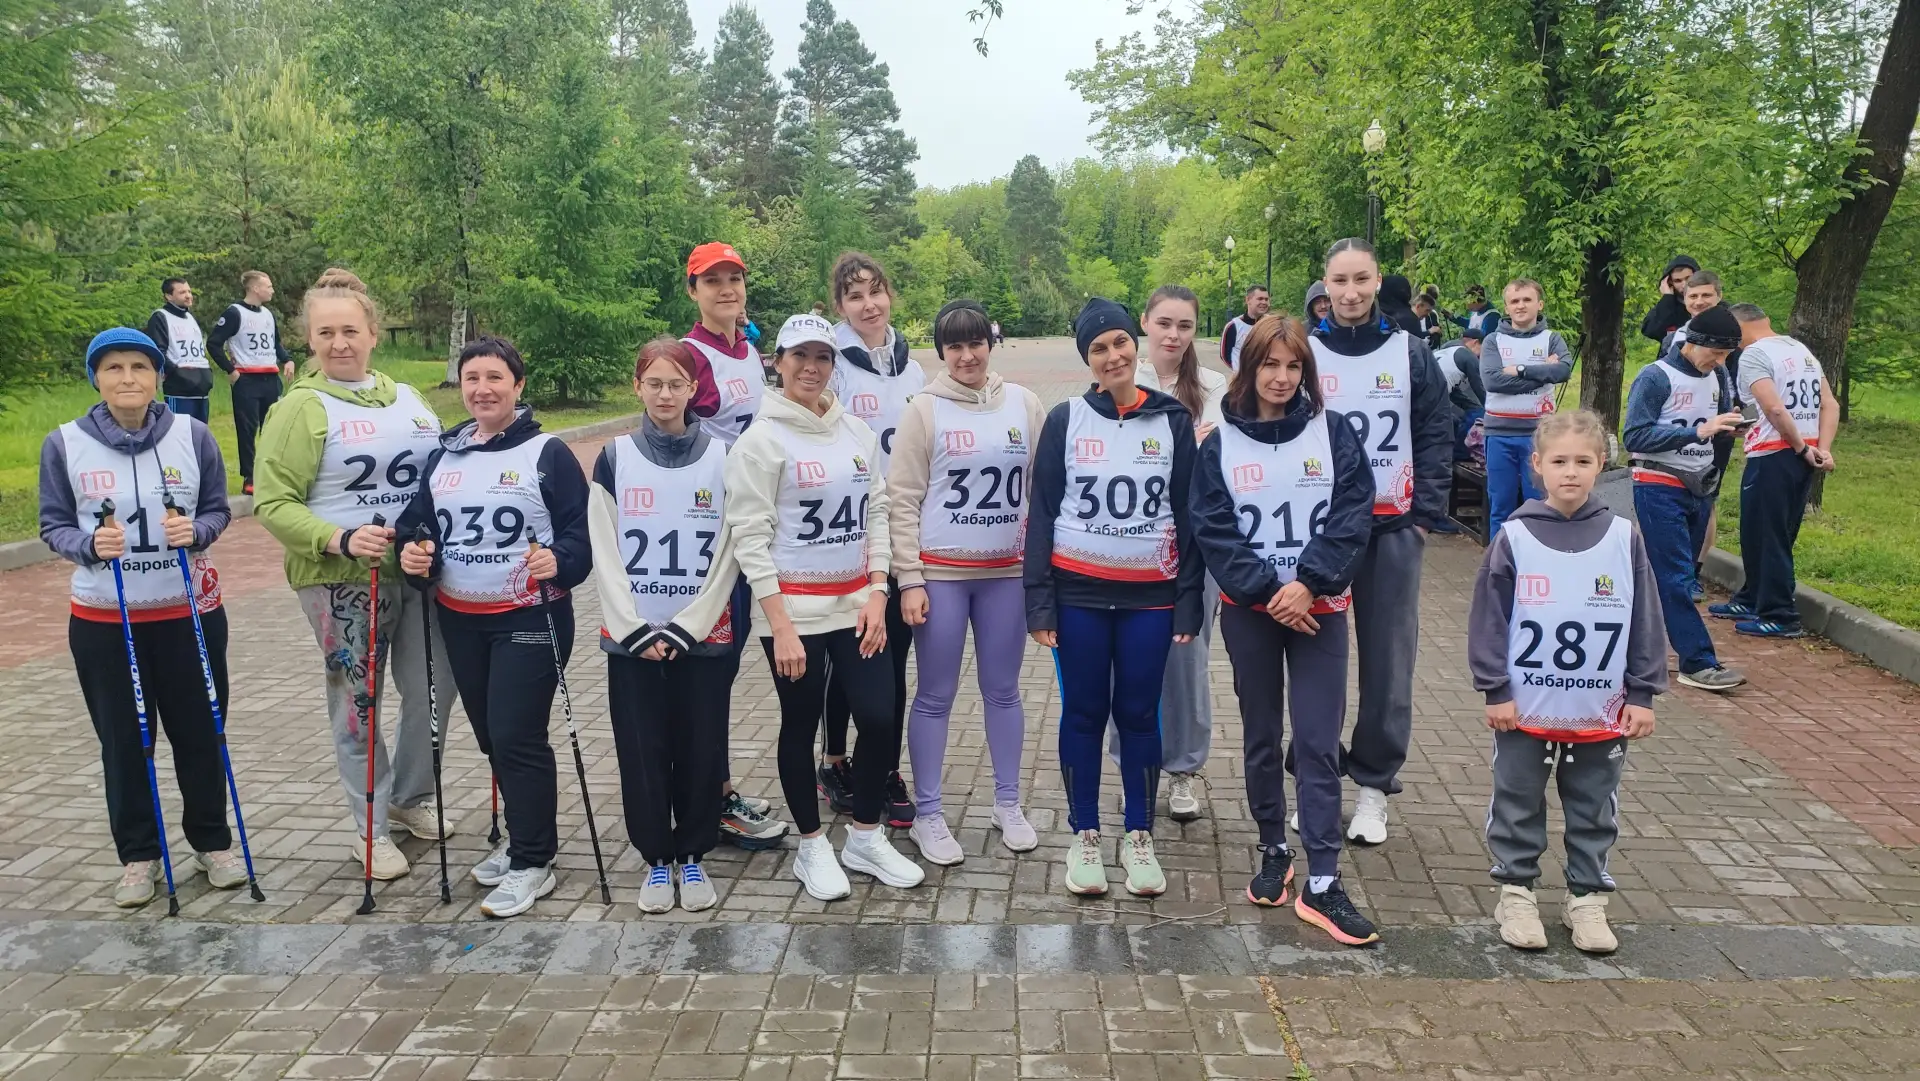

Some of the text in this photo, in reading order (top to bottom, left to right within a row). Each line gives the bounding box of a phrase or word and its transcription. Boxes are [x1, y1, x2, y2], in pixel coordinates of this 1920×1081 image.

[1784, 379, 1821, 409] 388
[1343, 410, 1400, 451] 92
[1074, 438, 1104, 457] ГТО
[343, 449, 440, 491] 26
[1233, 463, 1264, 486] ГТО
[624, 487, 654, 509] ГТО
[943, 466, 1022, 509] 320
[1075, 475, 1165, 519] 308
[436, 506, 524, 549] 239
[950, 512, 1019, 527] Хабаровск
[1084, 523, 1157, 537] Хабаровск
[101, 559, 181, 573] Хбаровс
[624, 528, 715, 578] 213
[1517, 574, 1550, 597] ГТО
[1514, 620, 1623, 671] 287
[130, 664, 143, 699] CMD
[1523, 672, 1612, 691] Хабаровск
